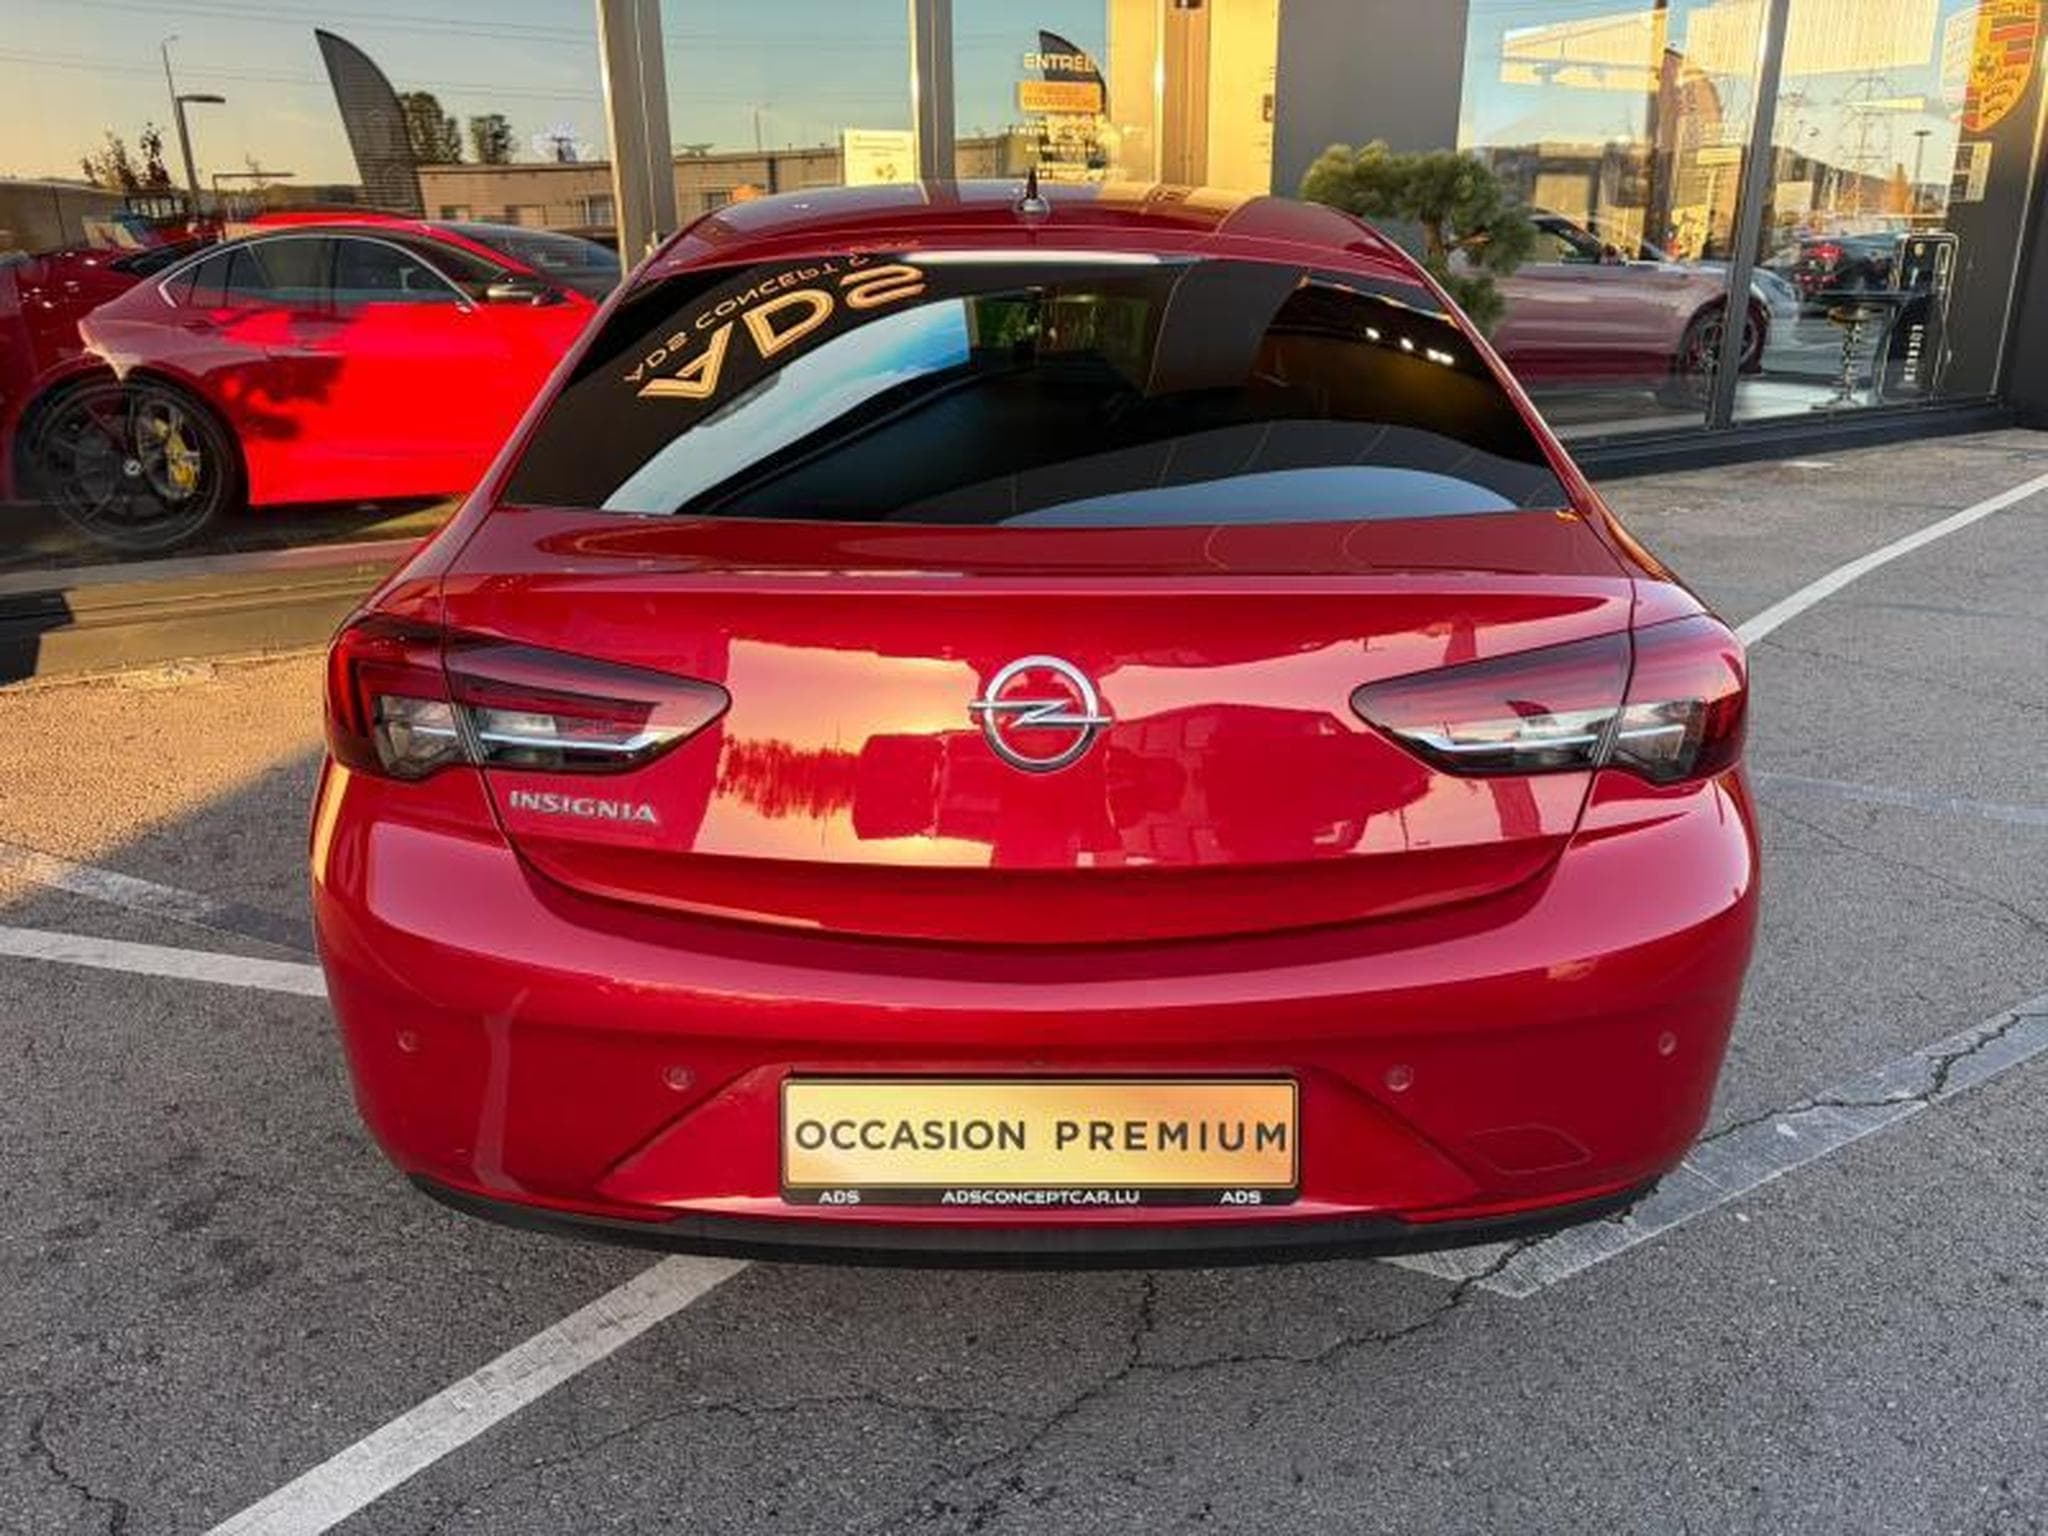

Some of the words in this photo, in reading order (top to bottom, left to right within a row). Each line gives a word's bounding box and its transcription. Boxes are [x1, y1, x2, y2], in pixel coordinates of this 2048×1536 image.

[510, 790, 658, 824] INSIGNIA
[795, 1120, 1026, 1151] OCCASION
[1055, 1120, 1287, 1152] PREMIUM
[818, 1190, 861, 1205] ADS
[941, 1190, 1141, 1205] ADSCONCEPTCAR.LU
[1219, 1190, 1262, 1205] ADS
